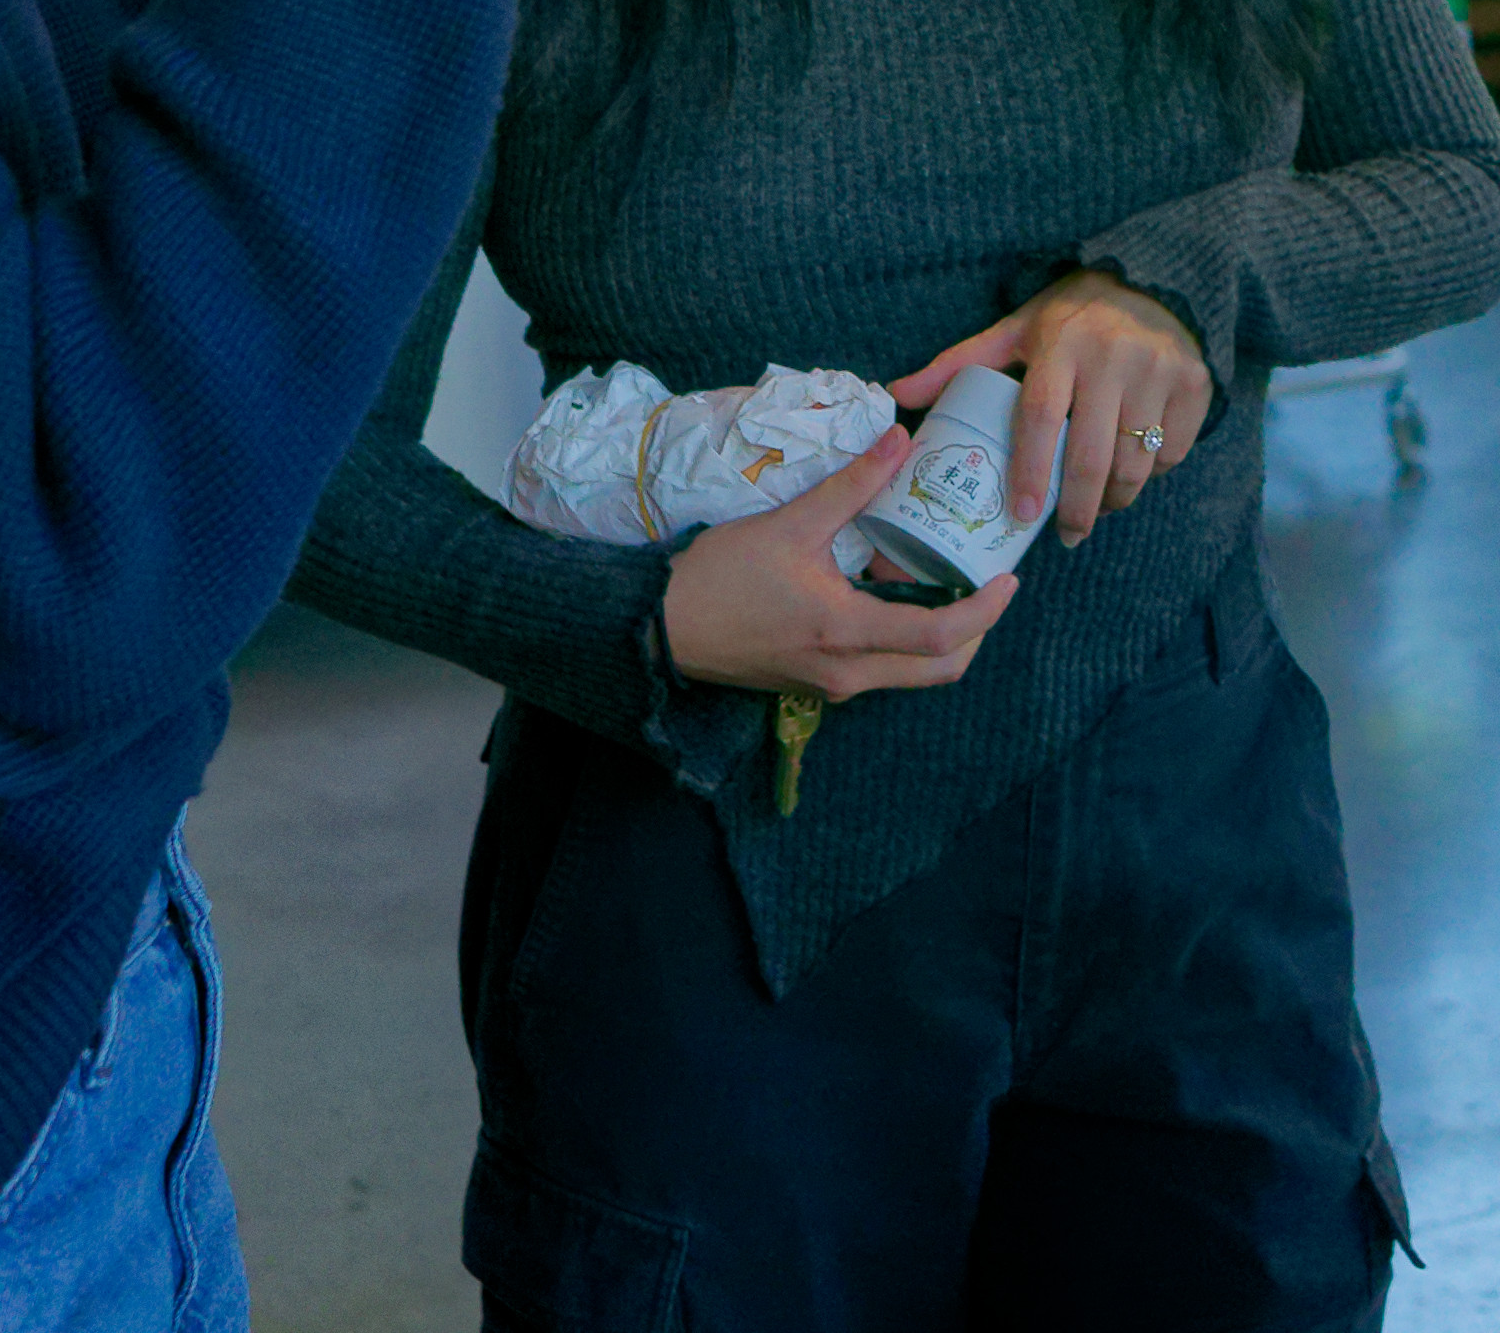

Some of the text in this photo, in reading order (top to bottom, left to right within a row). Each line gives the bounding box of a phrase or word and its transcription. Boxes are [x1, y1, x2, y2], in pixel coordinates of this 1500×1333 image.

[897, 502, 912, 515] NET
[922, 517, 938, 531] 1.05
[936, 527, 950, 538] OZ
